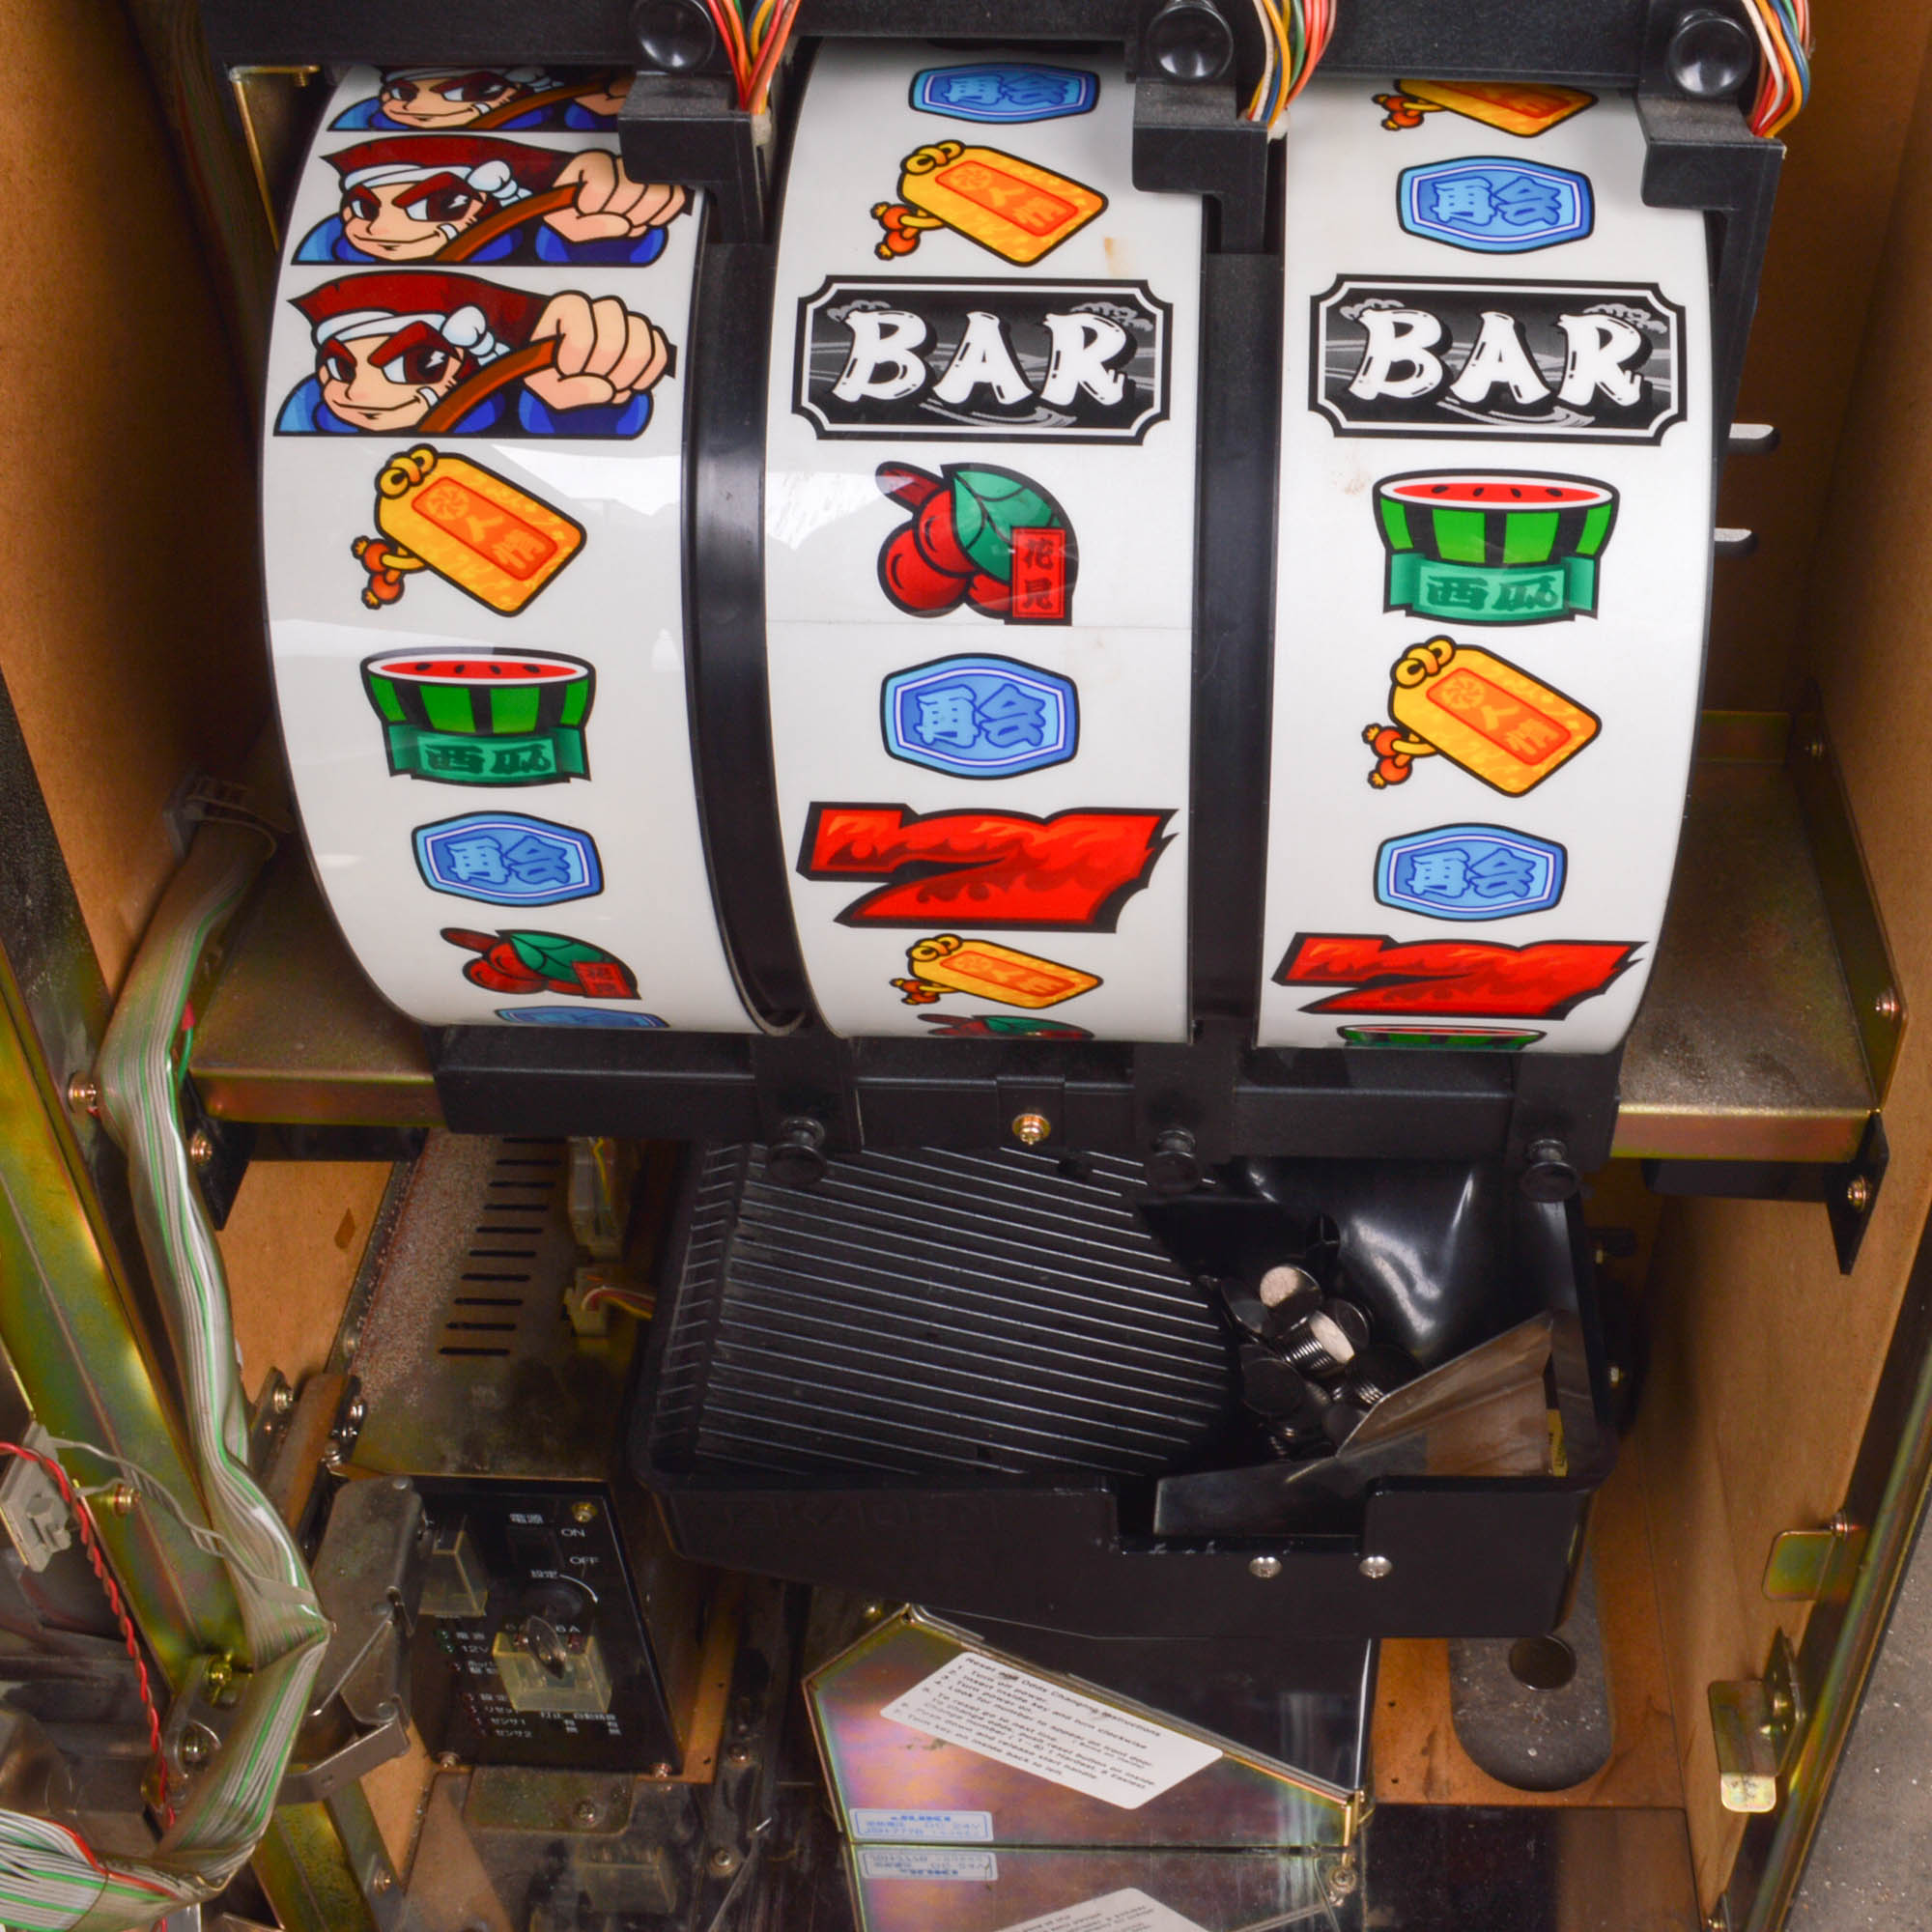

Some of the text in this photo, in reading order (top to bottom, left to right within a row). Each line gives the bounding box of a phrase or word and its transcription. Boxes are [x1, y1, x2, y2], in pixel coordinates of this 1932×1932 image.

[832, 309, 1130, 408] BAR
[1349, 307, 1643, 406] BAR
[1021, 536, 1056, 611] 花見
[1426, 575, 1560, 612] 西瓜
[426, 743, 552, 775] 西瓜
[560, 1528, 585, 1537] ON
[570, 1556, 598, 1565] OFF
[1021, 1680, 1048, 1693] Odds
